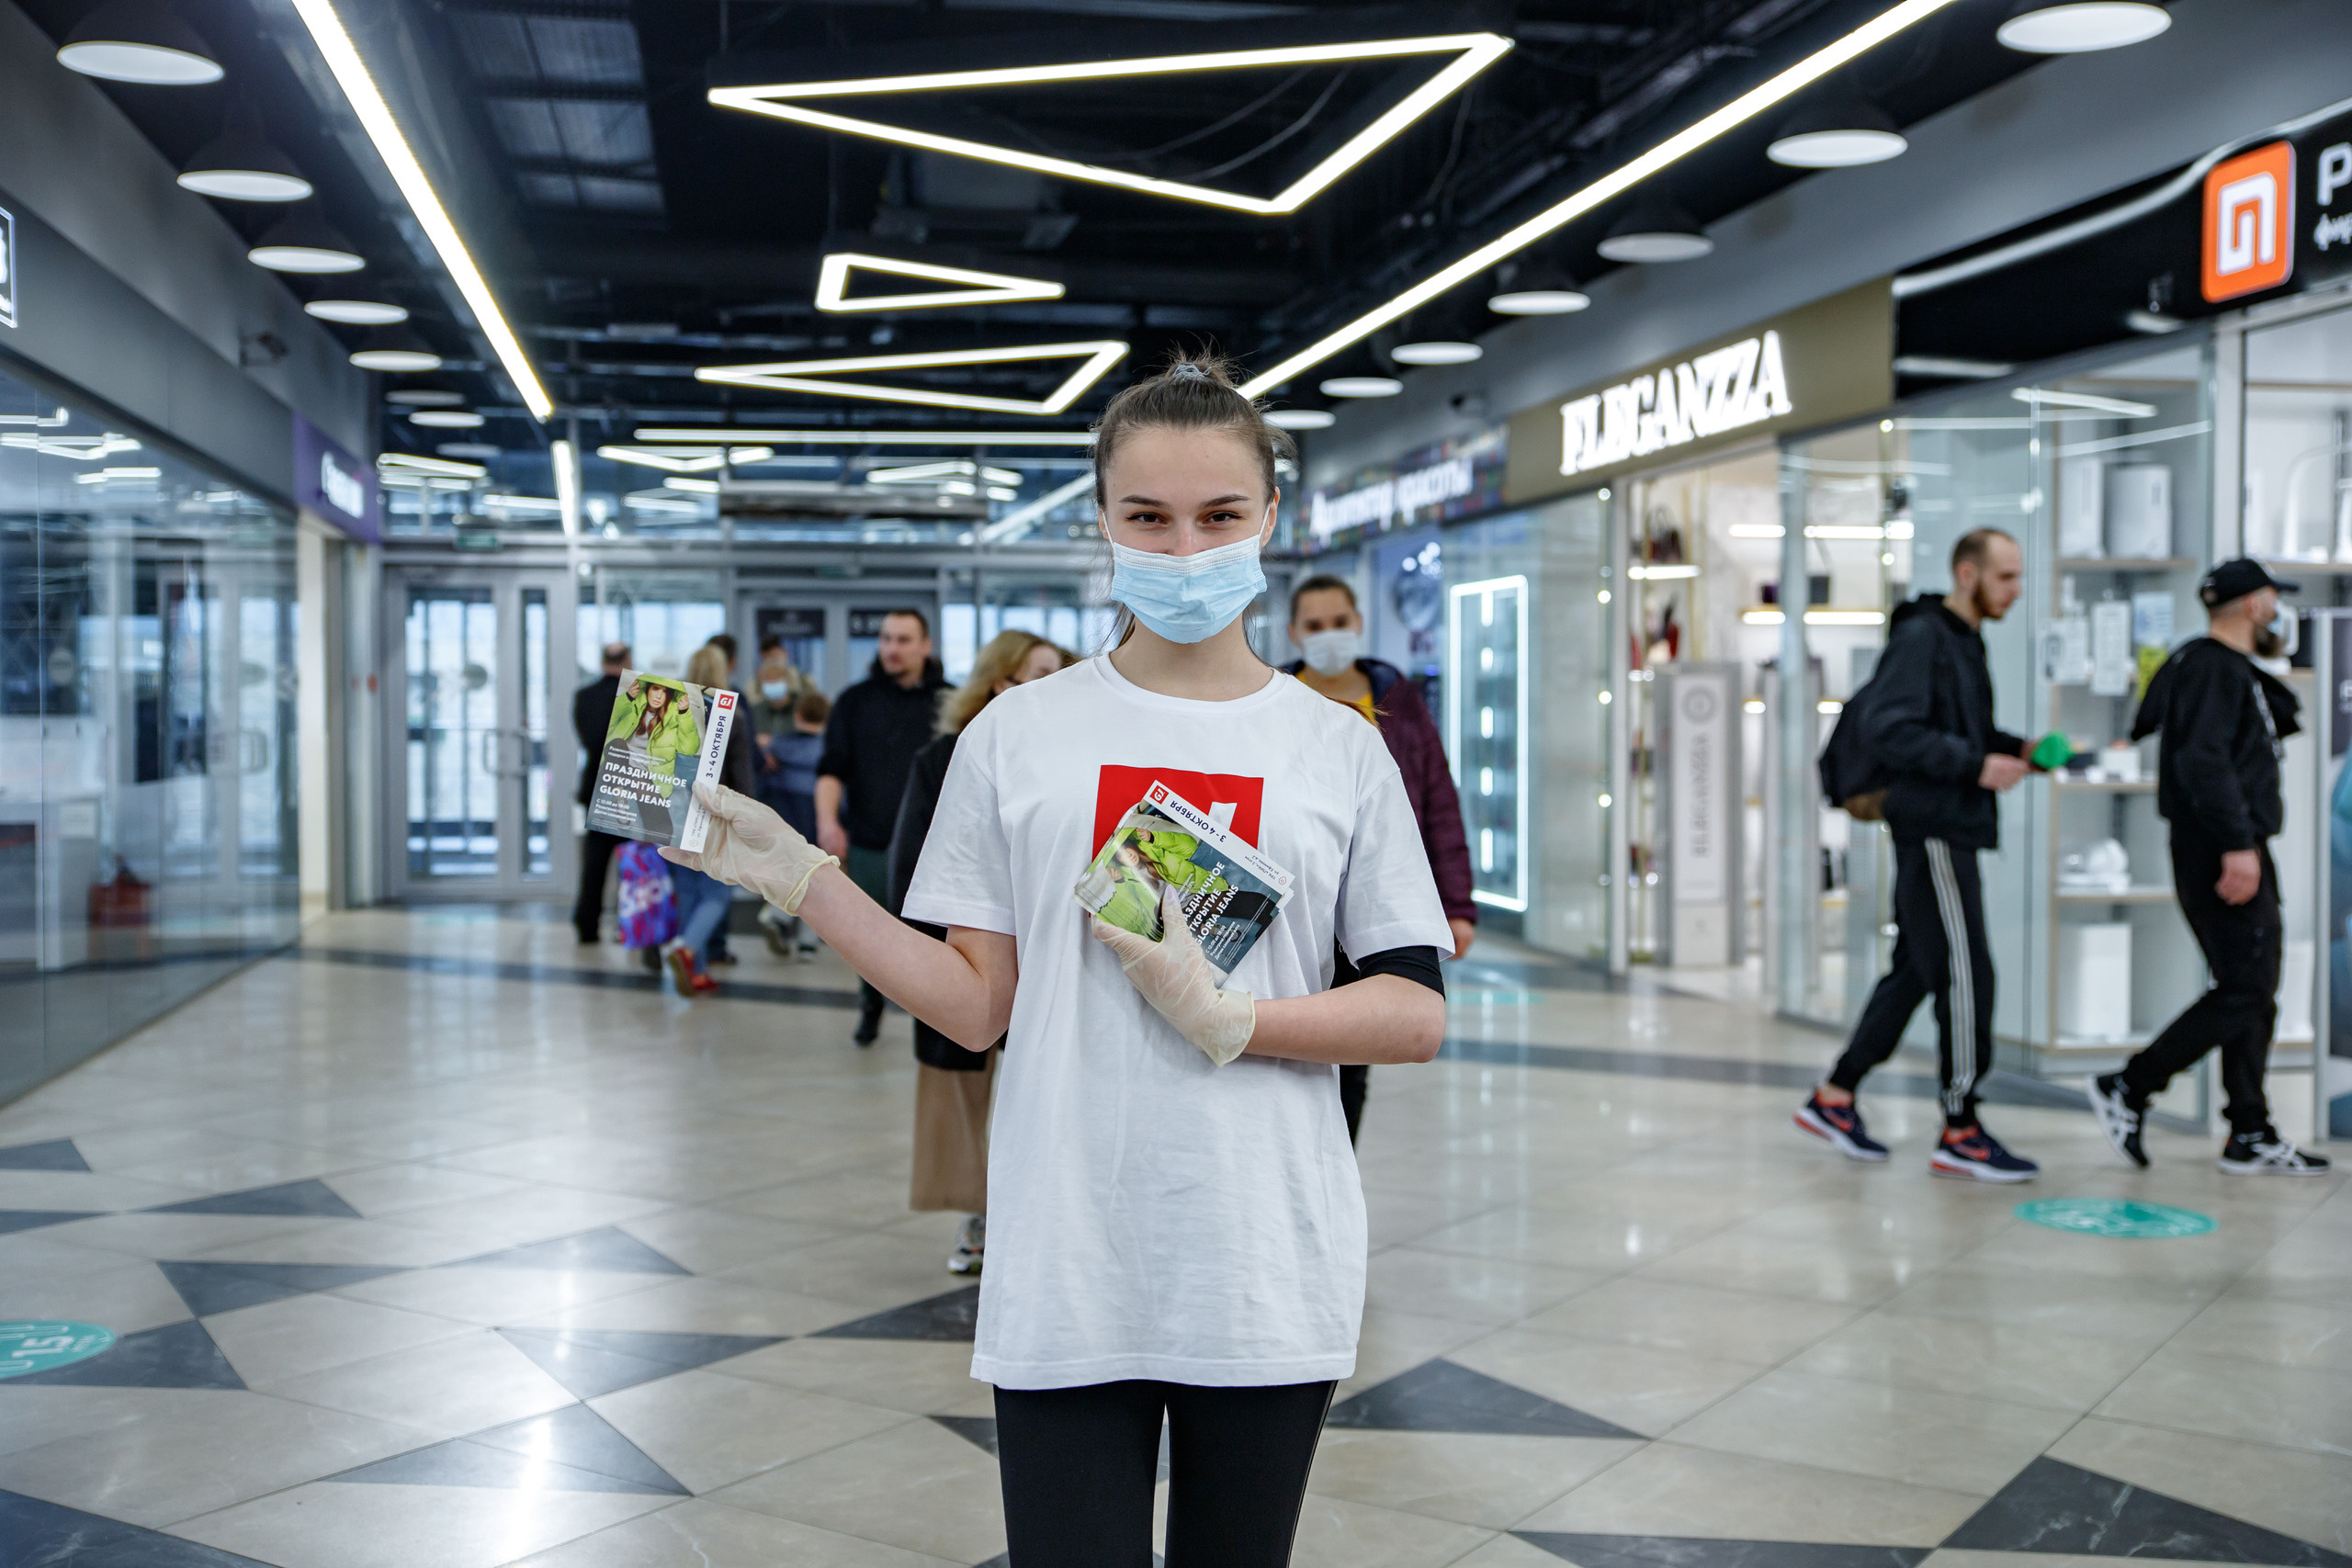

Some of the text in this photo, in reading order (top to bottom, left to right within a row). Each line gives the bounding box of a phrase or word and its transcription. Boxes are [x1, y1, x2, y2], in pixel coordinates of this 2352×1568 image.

[1561, 331, 1792, 476] ELEGANZZA
[719, 696, 732, 707] GJ
[709, 715, 726, 759] ОКТЯБРЯ
[602, 773, 661, 794] ОТКРЫТИЕ
[604, 761, 686, 788] ПРАЗДНИЧНОЕ
[599, 784, 672, 808] GLORIA JEANS
[1154, 787, 1166, 801] GJ
[1169, 799, 1210, 831] ОКТЯБРЯ
[1207, 826, 1216, 835] 4
[1218, 834, 1227, 842] 3
[1181, 860, 1225, 922] АЗДНИЧНОЕ
[1187, 887, 1221, 933] ТКРЫТИЕ
[1193, 883, 1239, 945] GLORIA JEANS
